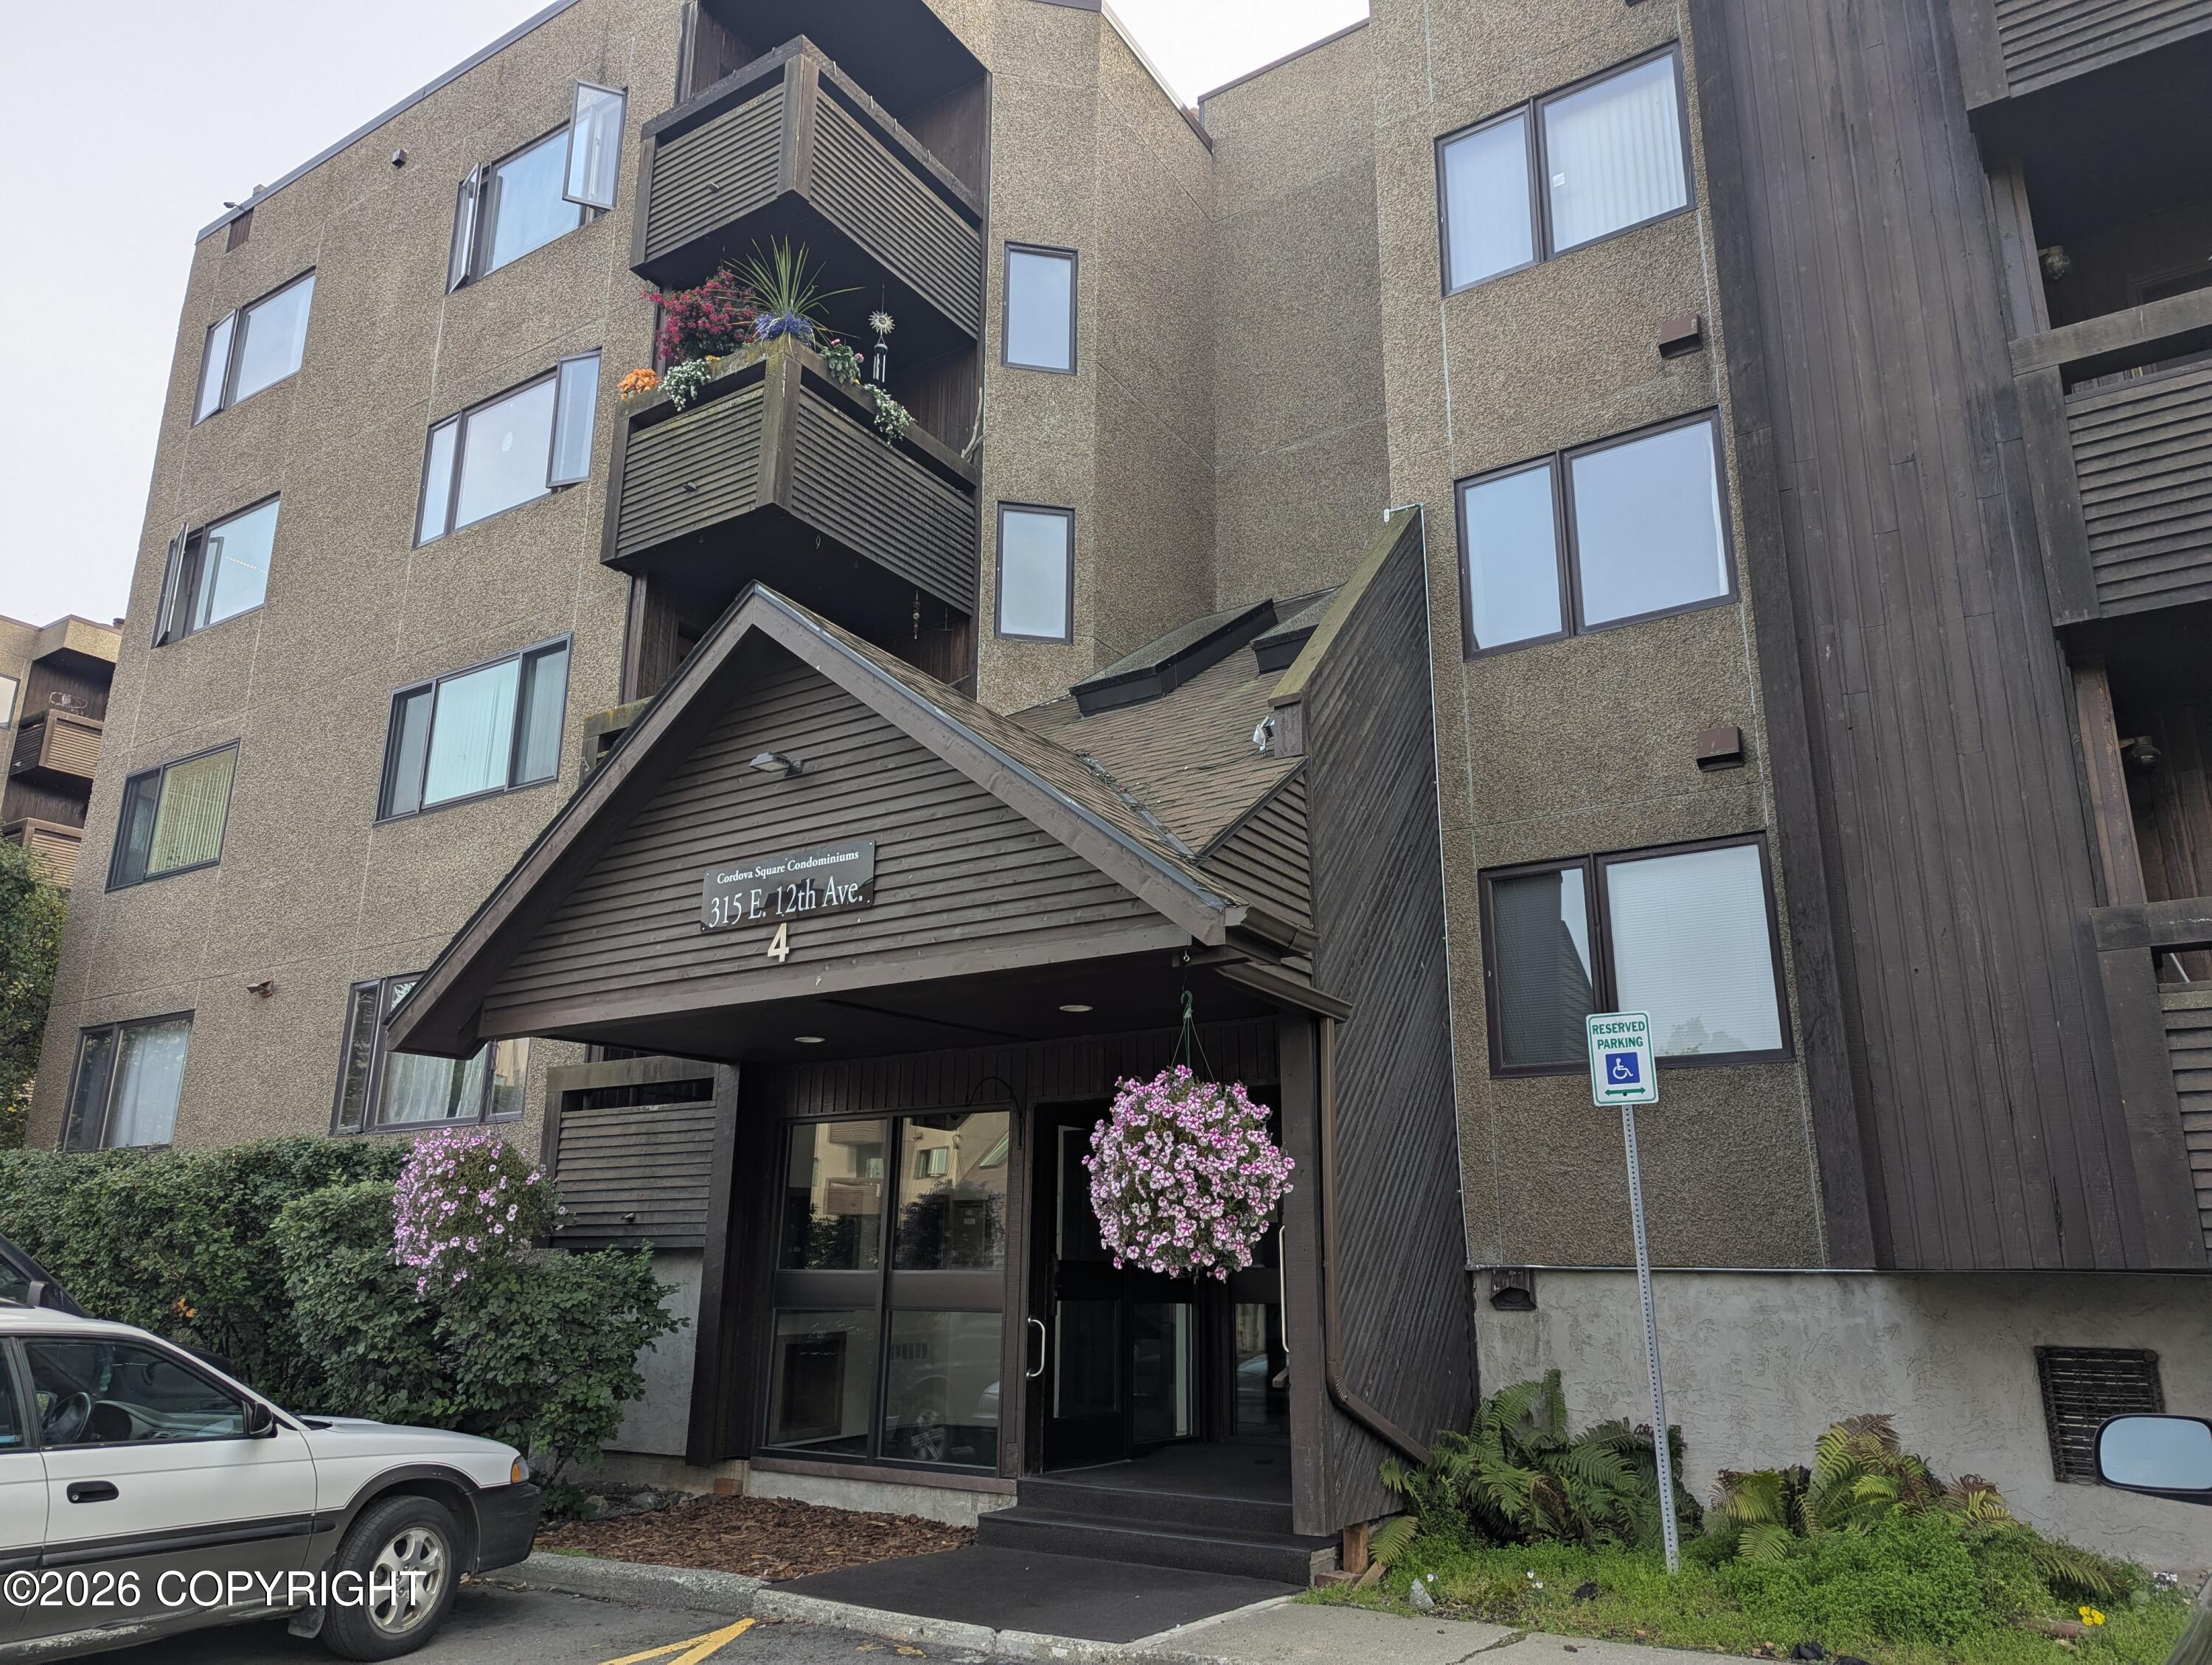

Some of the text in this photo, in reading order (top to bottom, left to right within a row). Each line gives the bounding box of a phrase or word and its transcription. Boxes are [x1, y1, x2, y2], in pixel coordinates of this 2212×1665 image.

[717, 851, 859, 884] Cordova Square Condominiums
[709, 875, 863, 928] 315 E. 12th Ave.
[768, 922, 790, 962] 4
[1592, 1021, 1646, 1035] RESERVED
[1597, 1036, 1644, 1049] PARKING
